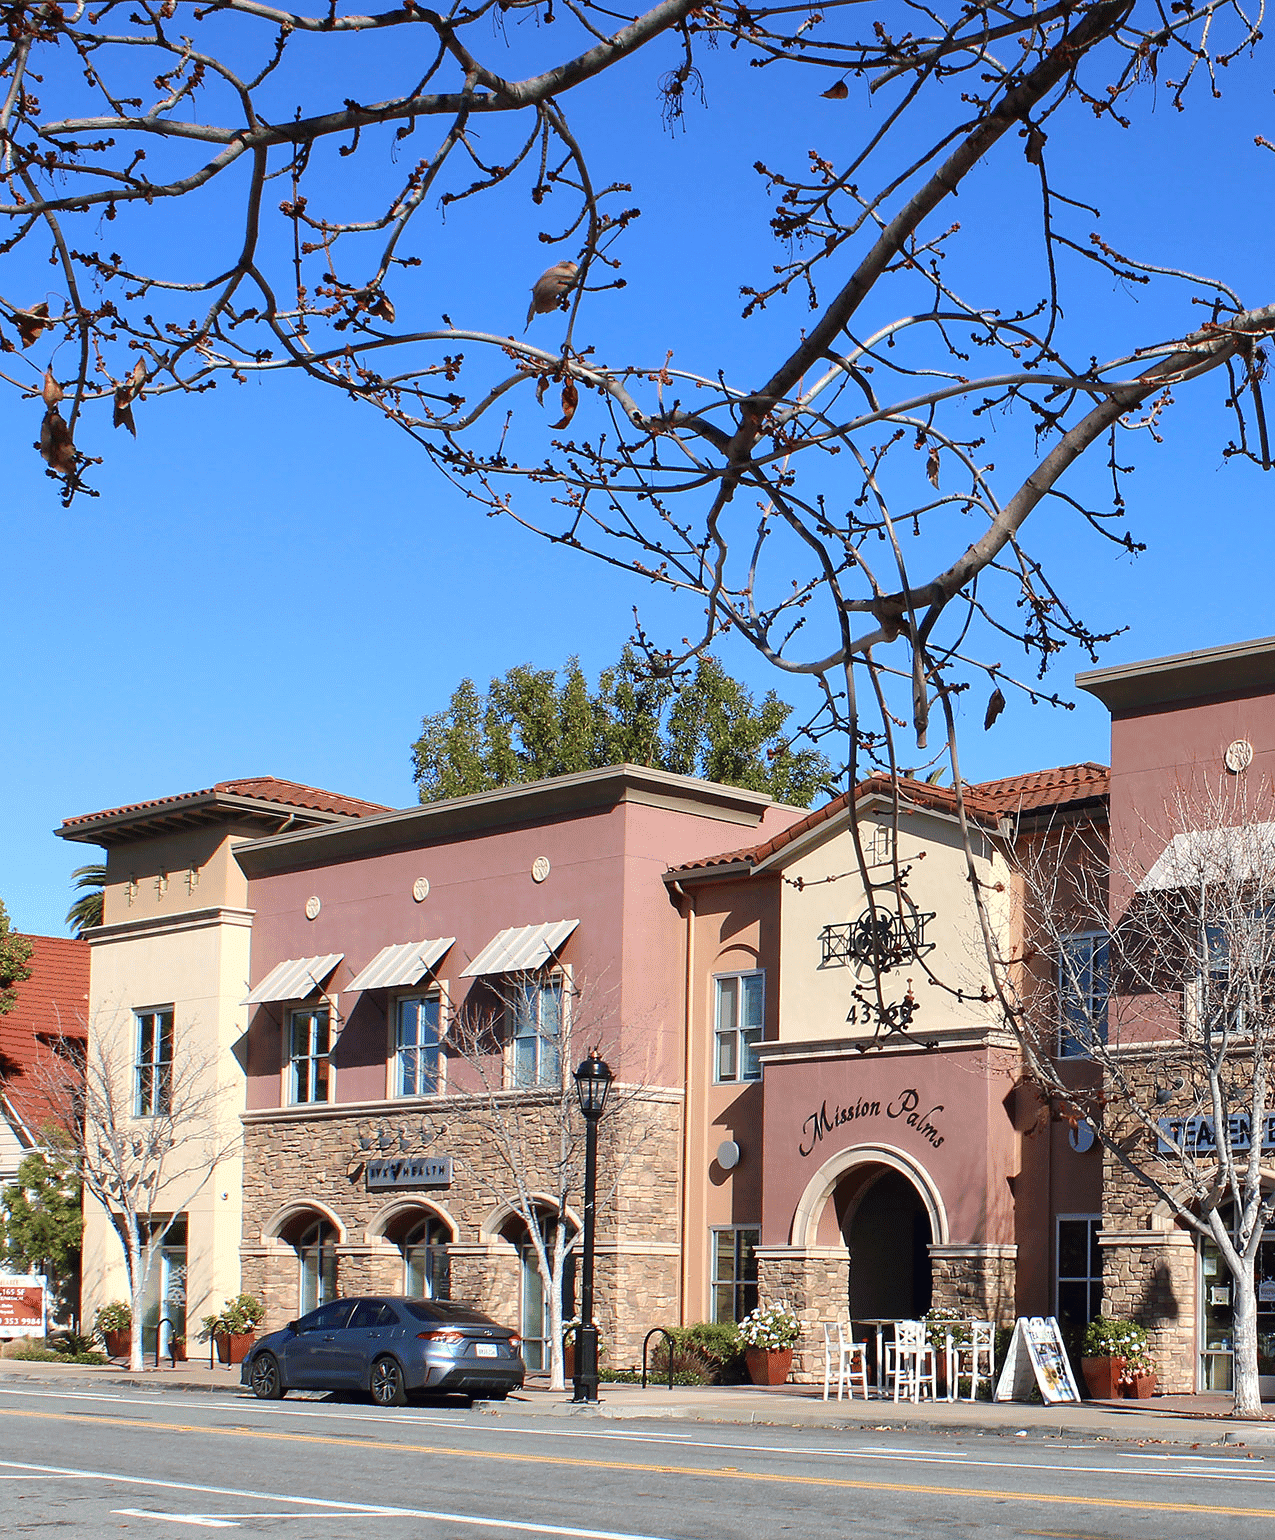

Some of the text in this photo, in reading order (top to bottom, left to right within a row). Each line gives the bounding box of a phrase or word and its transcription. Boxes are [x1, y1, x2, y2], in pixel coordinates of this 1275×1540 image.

[799, 1088, 945, 1157] Mission Palms
[403, 1165, 445, 1177] HEALTH
[4, 1317, 20, 1325] 353
